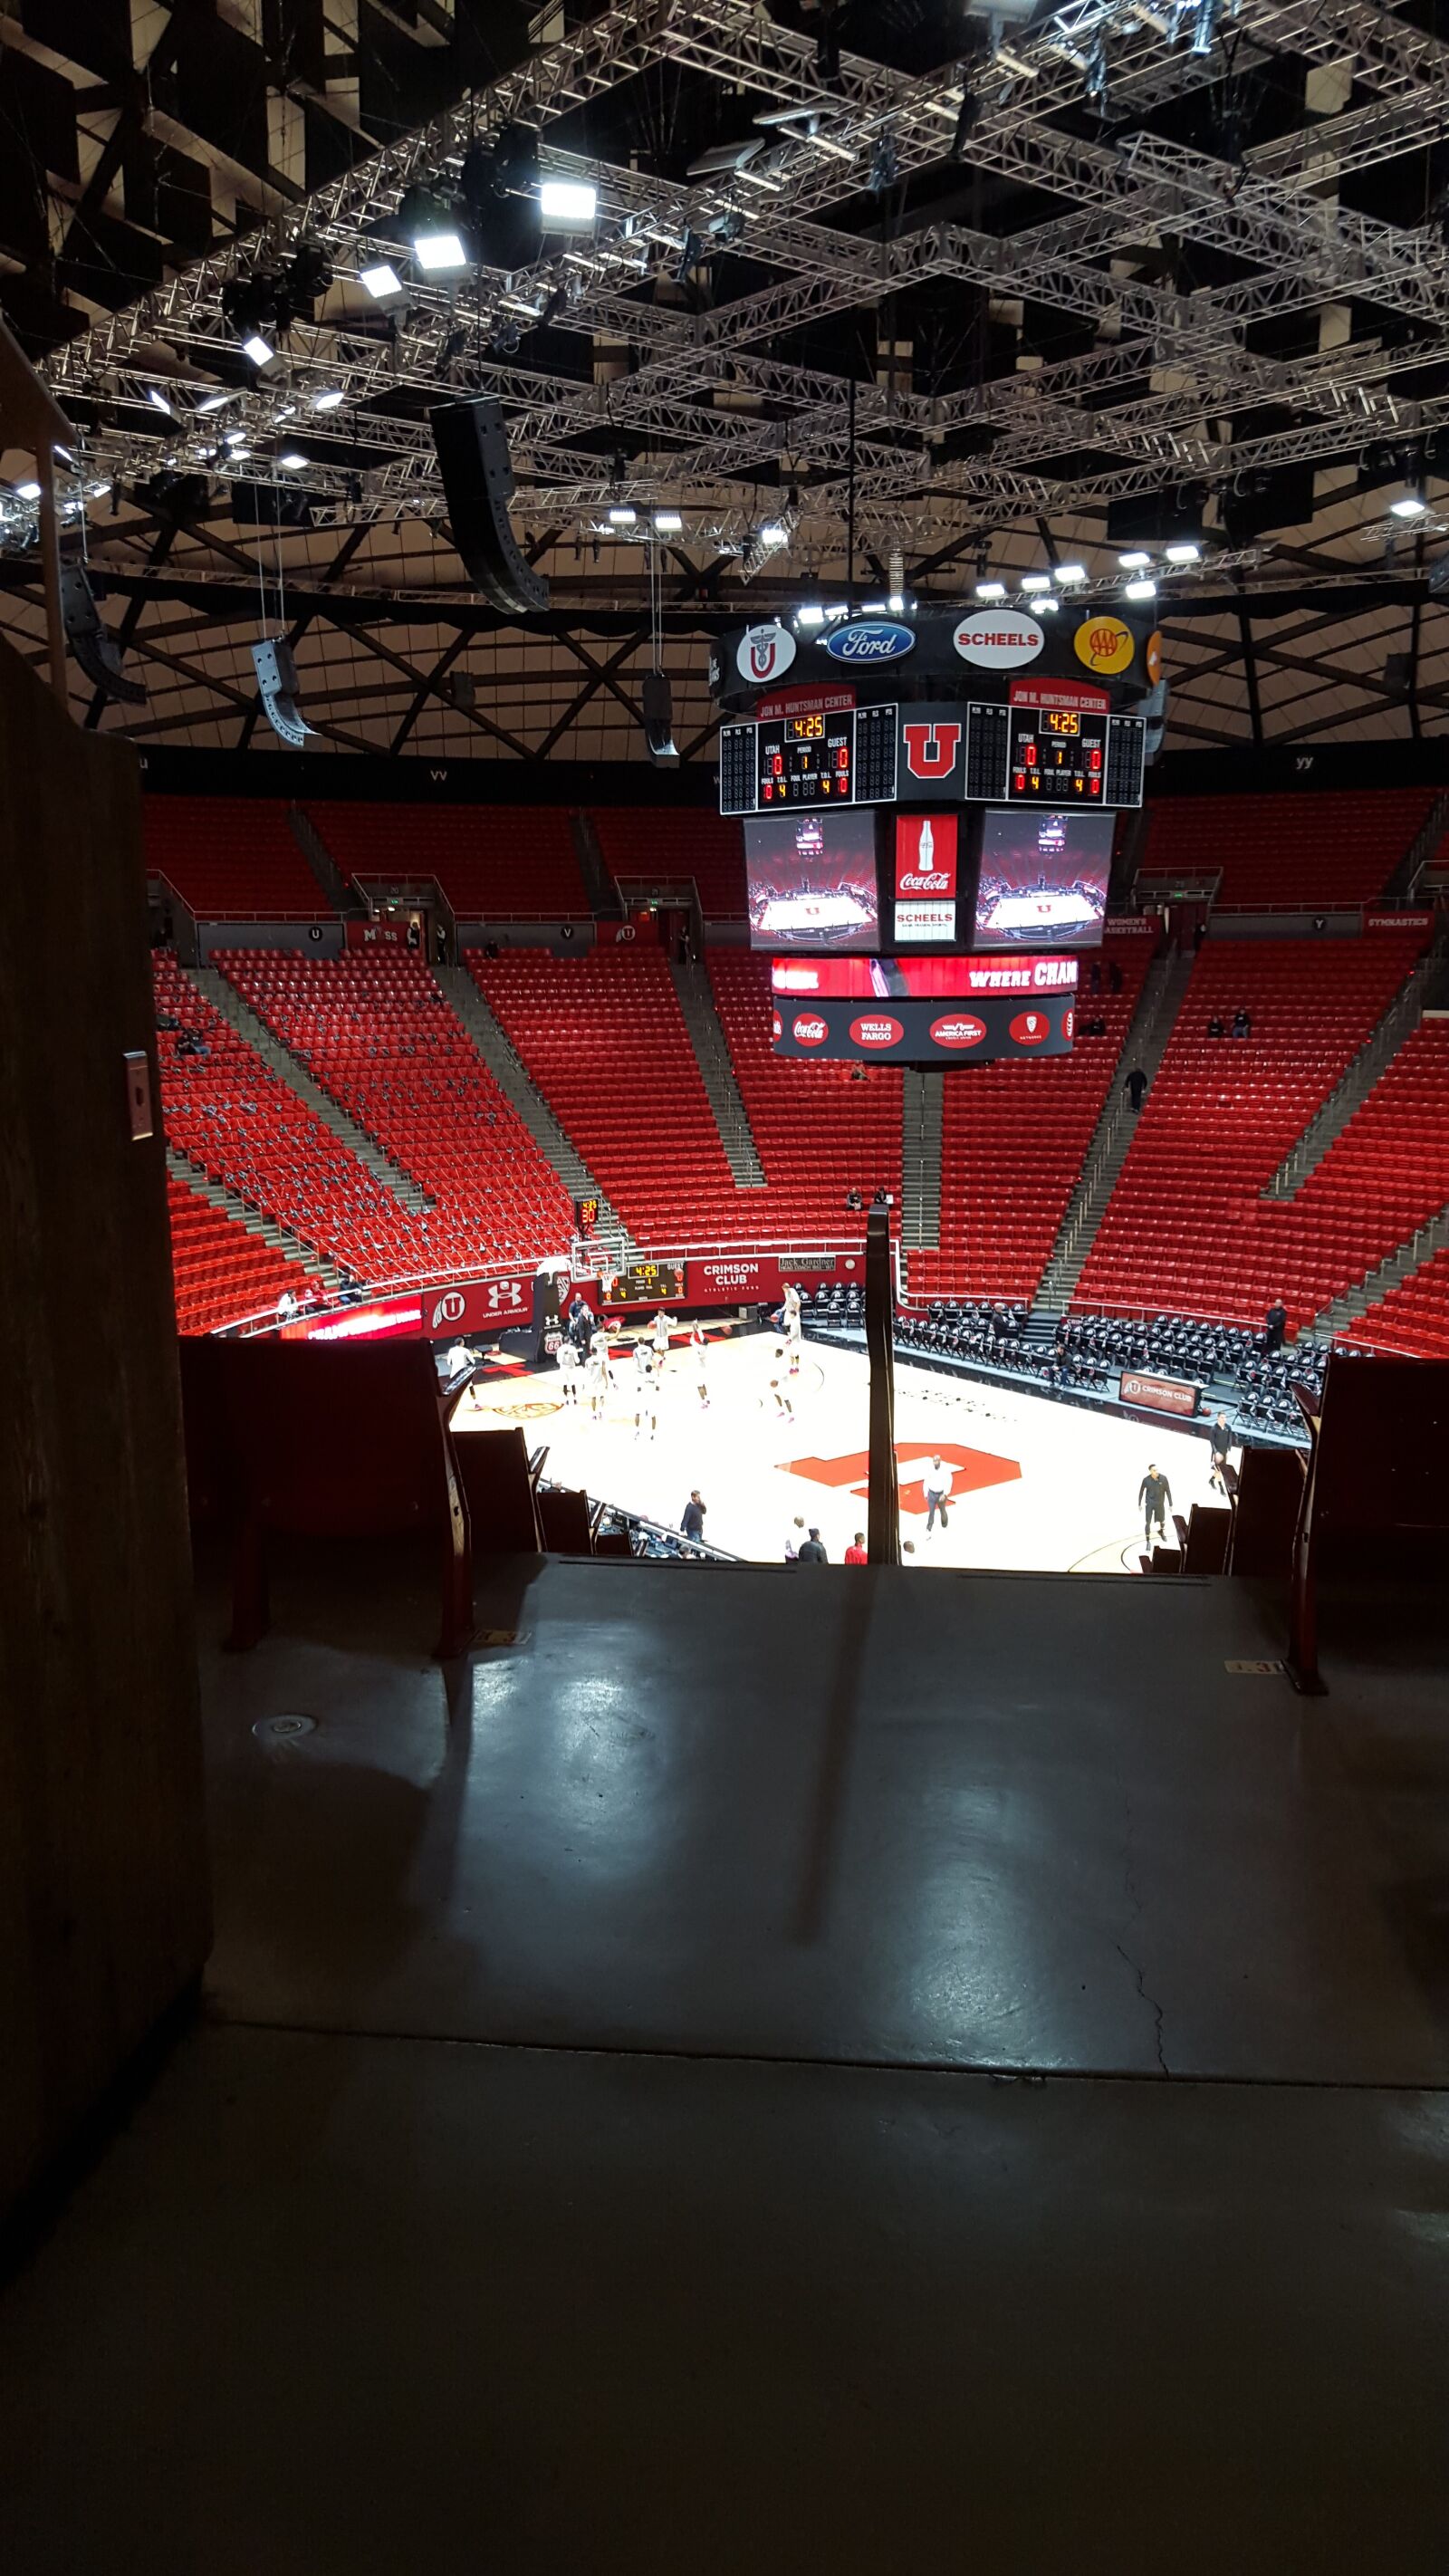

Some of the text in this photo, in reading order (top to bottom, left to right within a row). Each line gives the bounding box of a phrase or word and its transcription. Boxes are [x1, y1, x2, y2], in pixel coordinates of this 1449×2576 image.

[842, 629, 897, 657] Ford
[958, 632, 1039, 647] SCHEELS
[761, 694, 852, 718] JON M. HUNTSMAN CENTER
[1013, 690, 1028, 703] JON
[1041, 693, 1080, 707] HUNTSMAN
[1080, 697, 1107, 710] CENTER
[794, 715, 823, 737] 4:25
[1050, 713, 1078, 734] 4:25
[828, 736, 848, 748] GUEST
[1018, 733, 1034, 744] UTAH
[1081, 738, 1101, 749] GUEST
[765, 745, 780, 755] UTAH
[797, 745, 811, 754] PERIOD
[903, 723, 962, 779] U
[1026, 745, 1037, 766] 0
[839, 747, 849, 769] 0
[1091, 750, 1101, 770] 0
[773, 755, 782, 775] 0
[802, 773, 818, 781] PLAYER
[835, 770, 849, 778] FOULS
[822, 780, 830, 793] 4
[1032, 776, 1039, 790] 4
[1075, 779, 1083, 792] 4
[779, 783, 786, 797] 4
[900, 872, 951, 890] Coca-Cola
[897, 913, 953, 922] SCHEELS
[1368, 918, 1428, 927] GYMNASTICS
[969, 971, 1031, 987] WHERE
[860, 1024, 892, 1032] WELLS
[861, 1032, 892, 1040] FARGO
[582, 1200, 597, 1210] 4:25
[582, 1209, 595, 1224] 30
[636, 1265, 657, 1276] 4:25
[704, 1264, 759, 1276] CRIMSON
[715, 1274, 747, 1286] CLUB
[483, 1306, 529, 1319] UNDER ARMOUR
[548, 1341, 561, 1350] 66
[1142, 1385, 1192, 1403] CRIMSON CLUB
